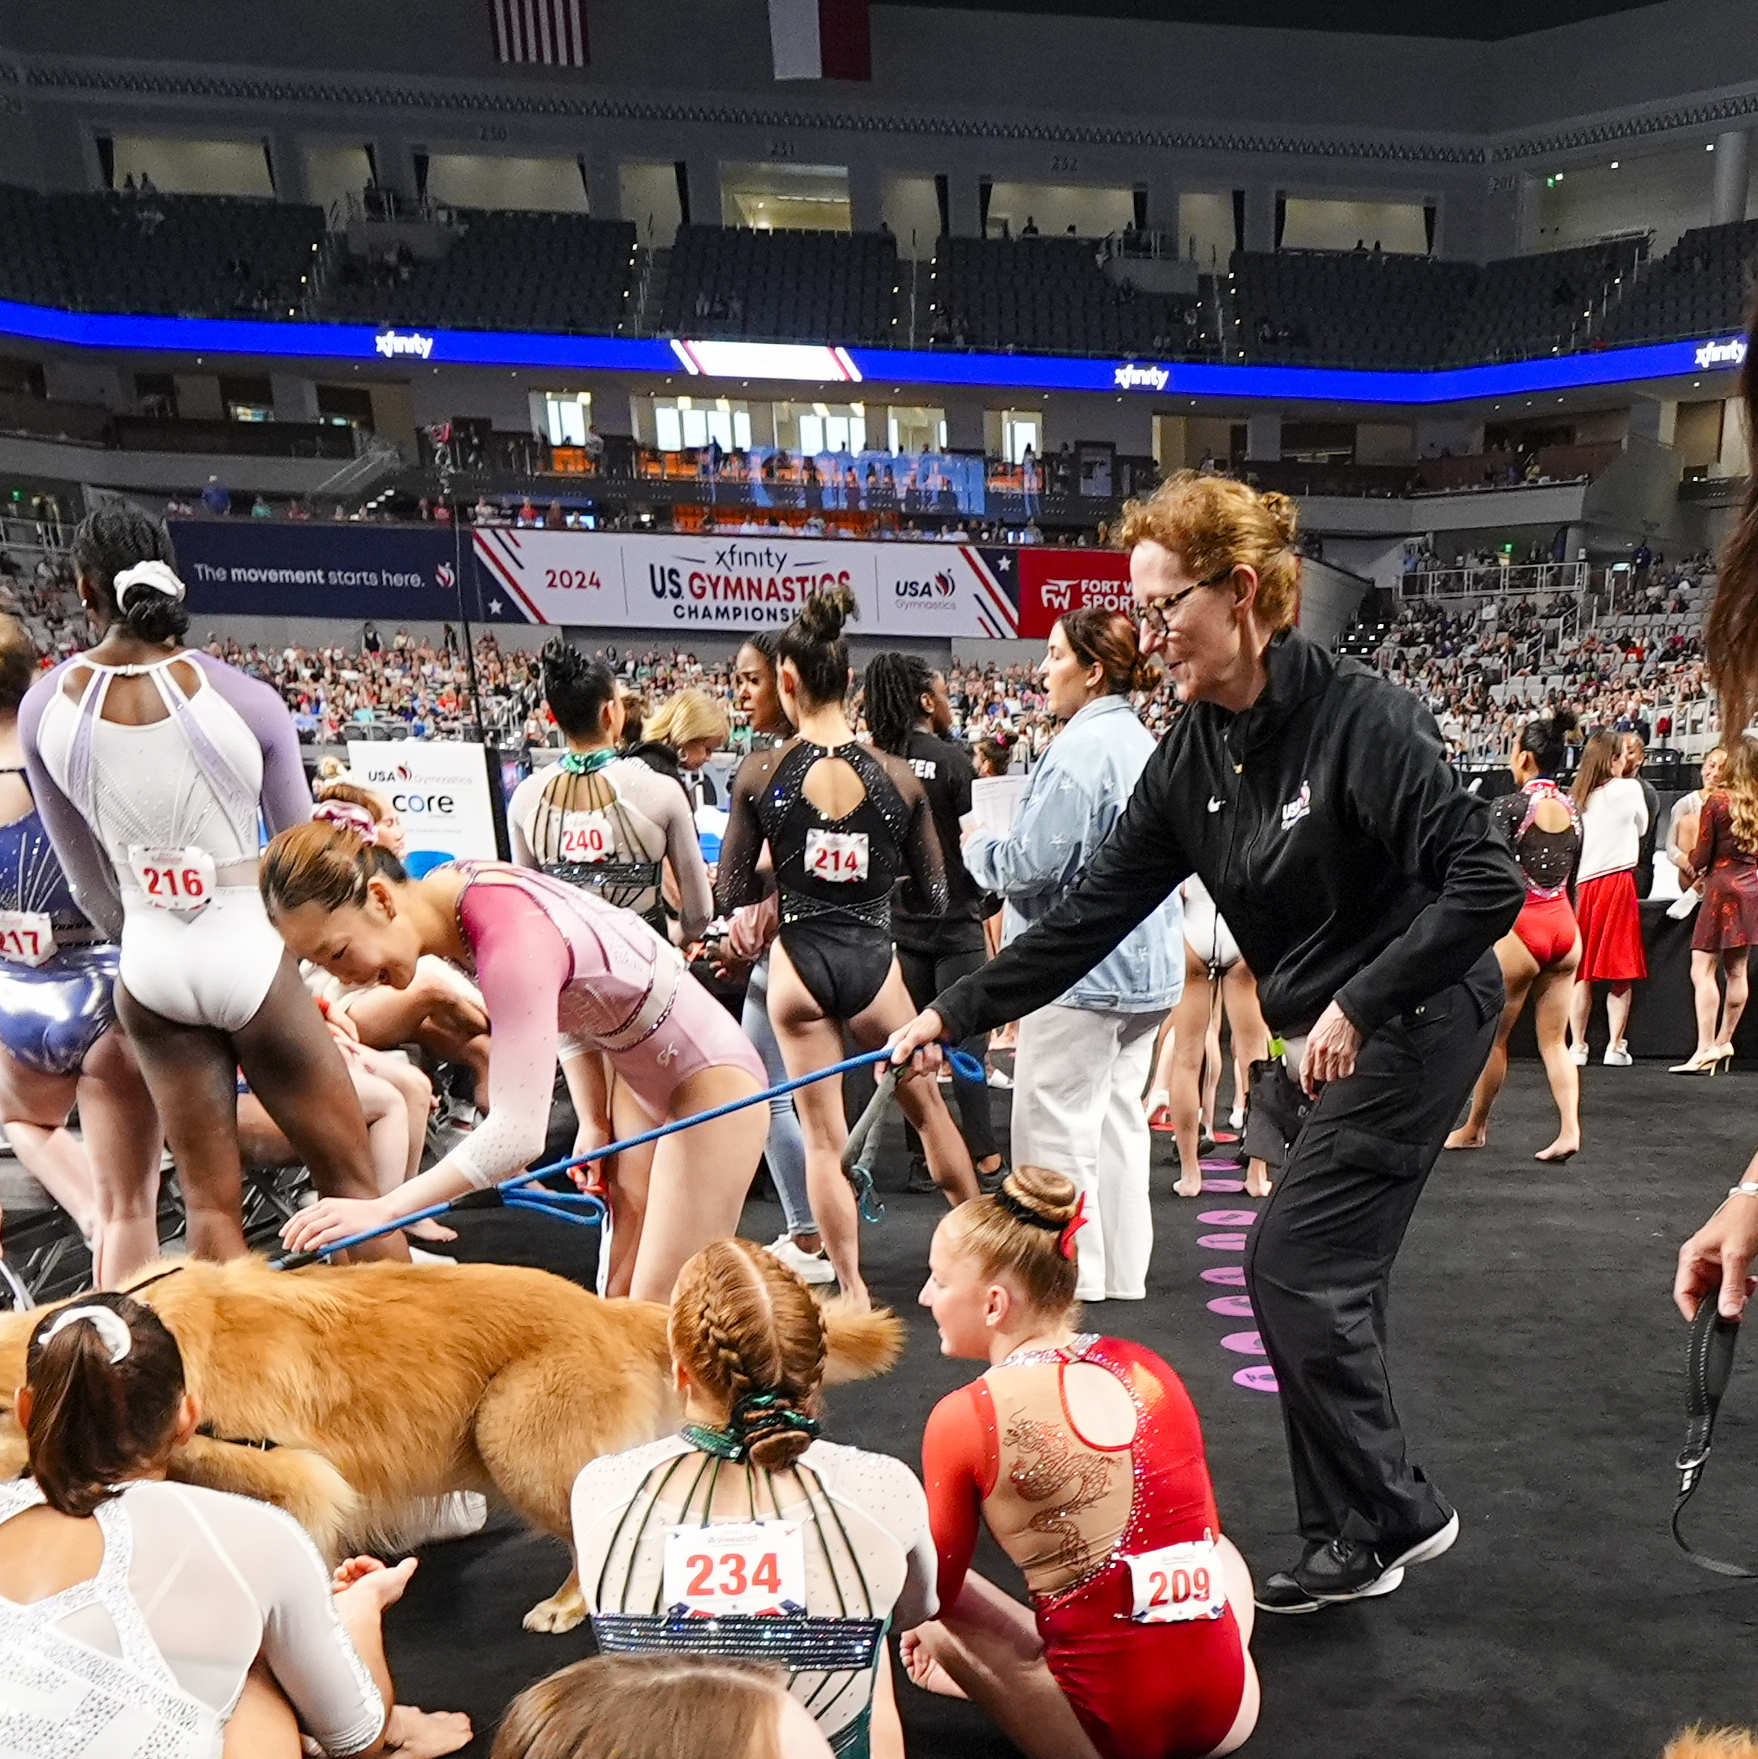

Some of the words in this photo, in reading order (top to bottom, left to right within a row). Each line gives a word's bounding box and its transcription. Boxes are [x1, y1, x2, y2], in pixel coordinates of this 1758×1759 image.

[375, 330, 433, 359] xfinity
[1694, 340, 1748, 368] xfinity
[1114, 364, 1169, 390] xfinity
[715, 544, 788, 573] xfinity
[194, 563, 227, 582] The
[231, 567, 325, 585] movement
[328, 569, 378, 587] starts
[382, 569, 425, 588] here.
[545, 568, 601, 590] 2024
[650, 563, 685, 599] U.S.
[1081, 579, 1121, 594] FORT
[895, 580, 933, 598] USA
[673, 604, 801, 623] CHAMPIONS
[895, 598, 957, 611] Gymnastics
[1081, 595, 1140, 612] SPORT
[368, 771, 396, 782] USA
[392, 795, 454, 813] core
[562, 829, 603, 851] 240
[815, 848, 858, 870] 214
[144, 868, 203, 896] 216
[686, 1553, 782, 1596] 234
[1149, 1568, 1210, 1607] 209
